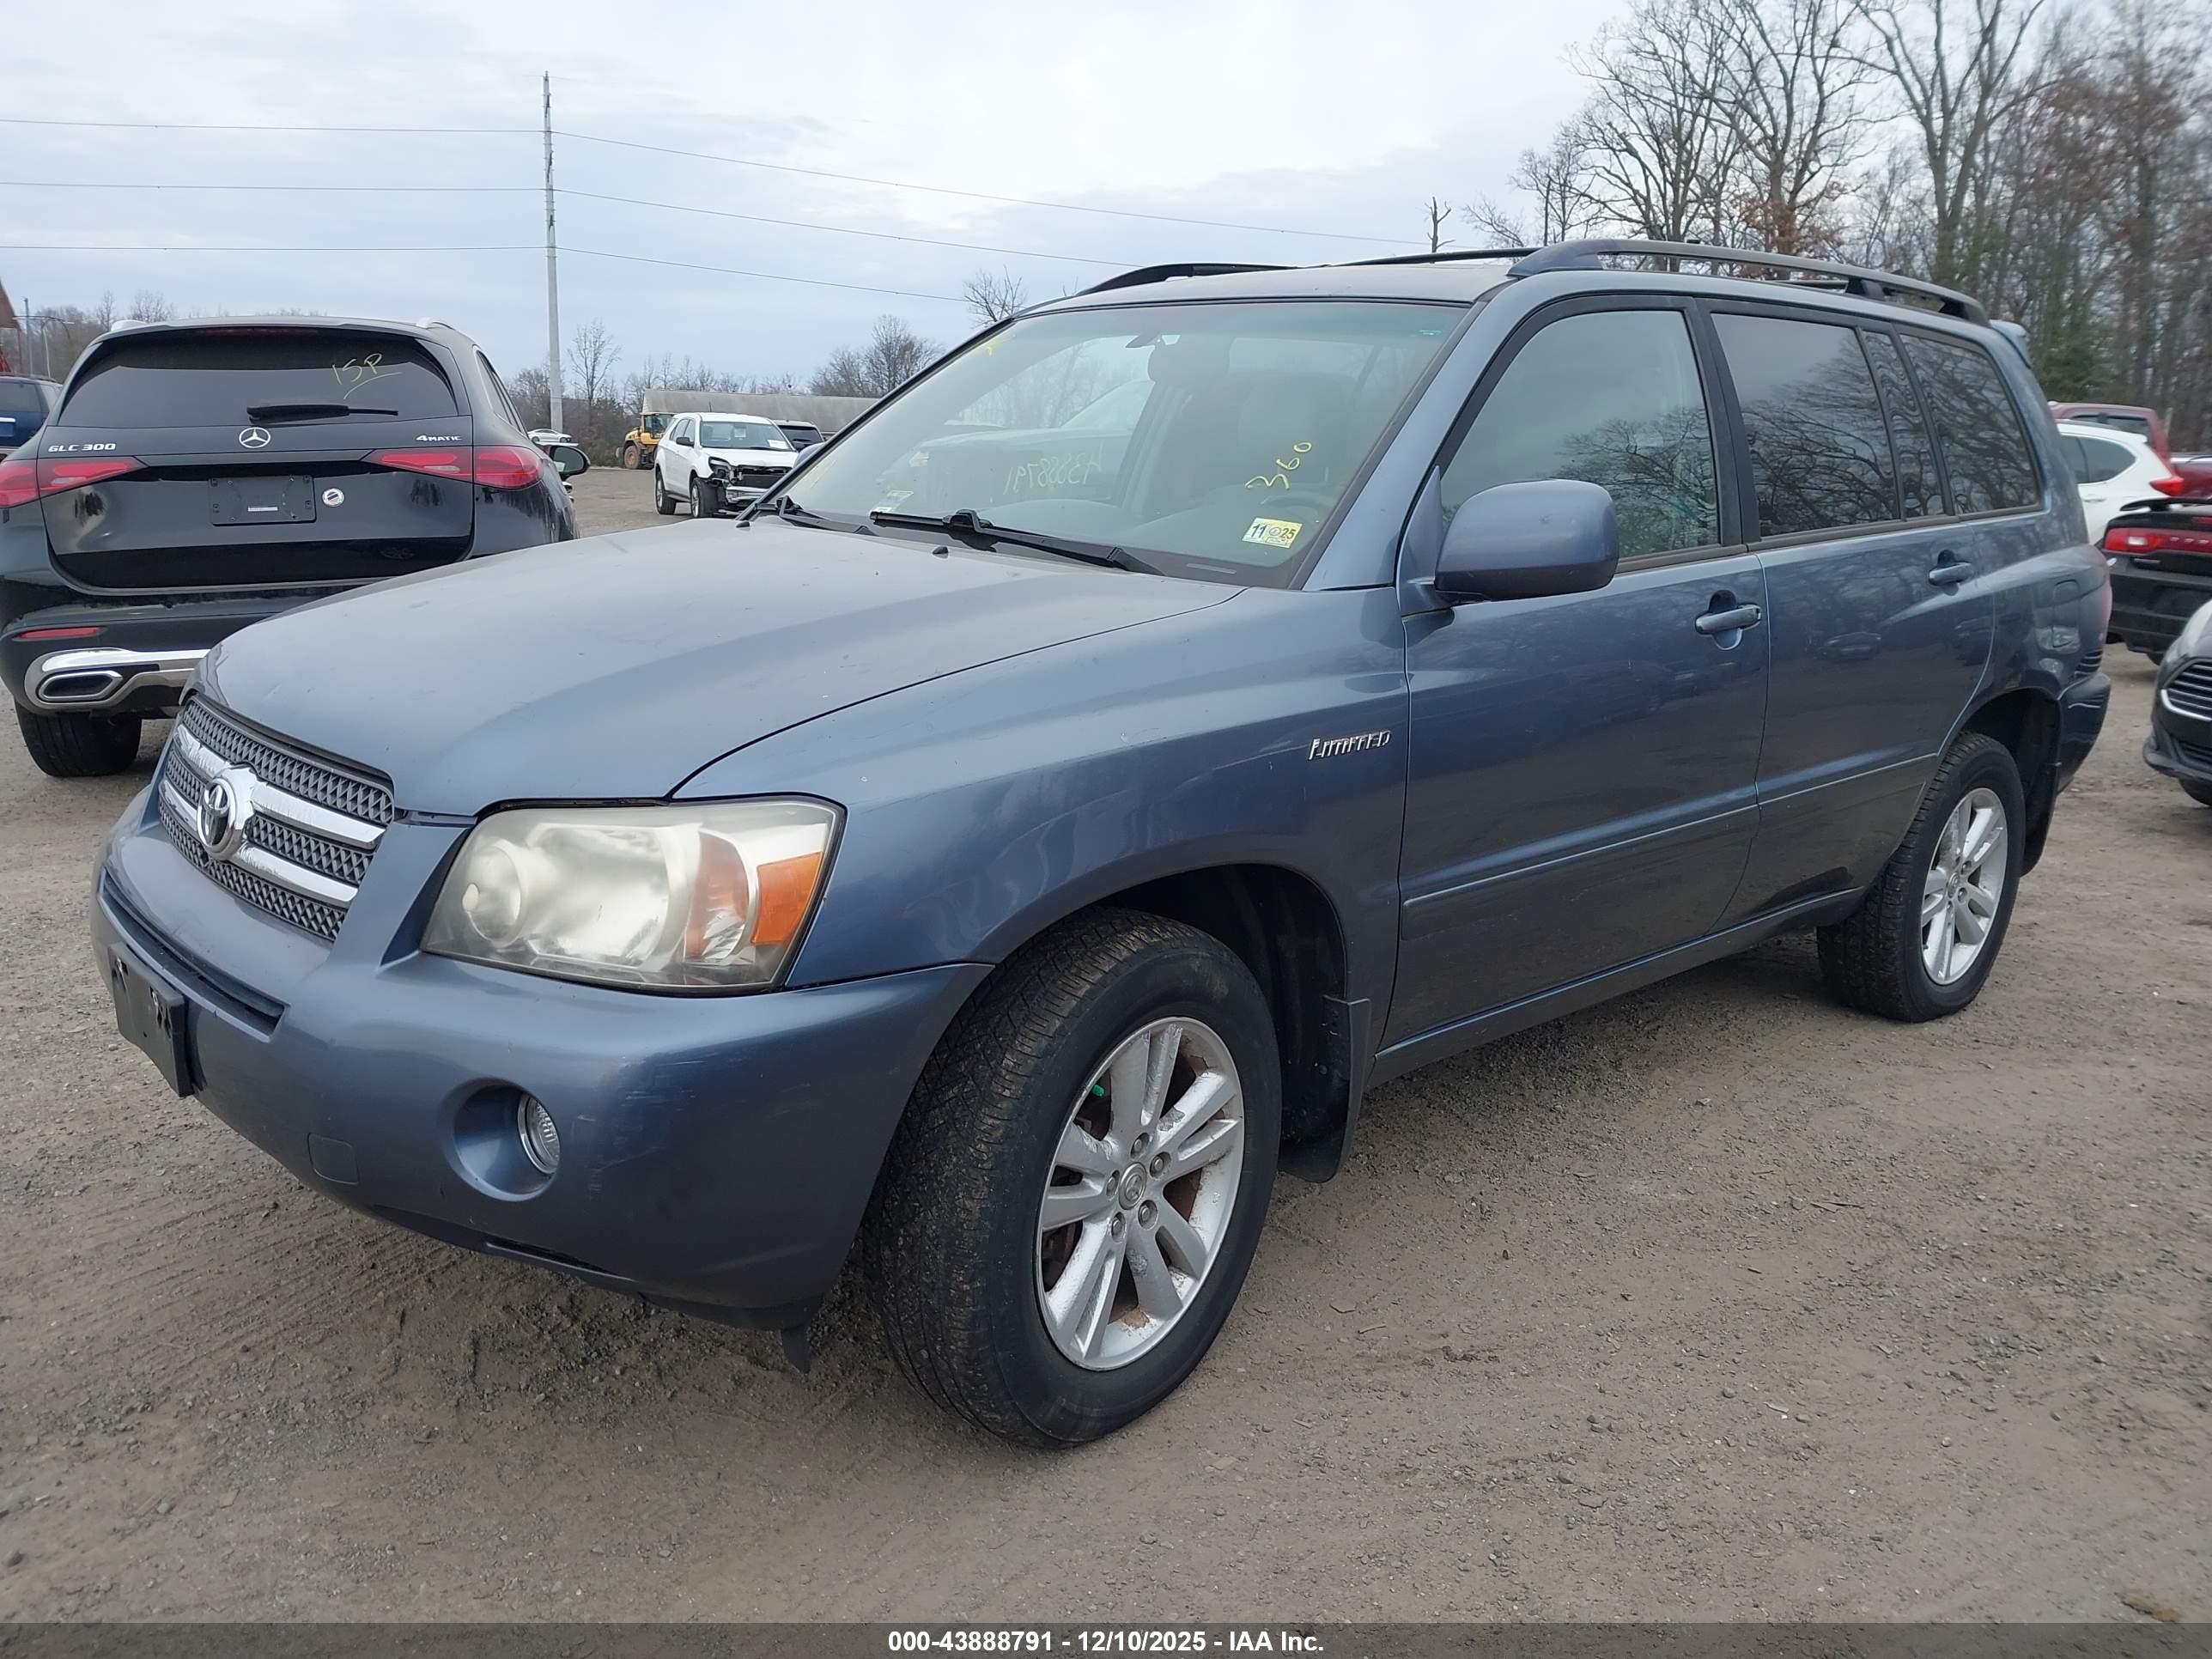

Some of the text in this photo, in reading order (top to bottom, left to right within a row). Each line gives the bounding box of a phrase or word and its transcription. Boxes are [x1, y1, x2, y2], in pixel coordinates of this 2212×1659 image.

[1251, 524, 1297, 539] 11 25
[1309, 730, 1391, 761] LIMITED
